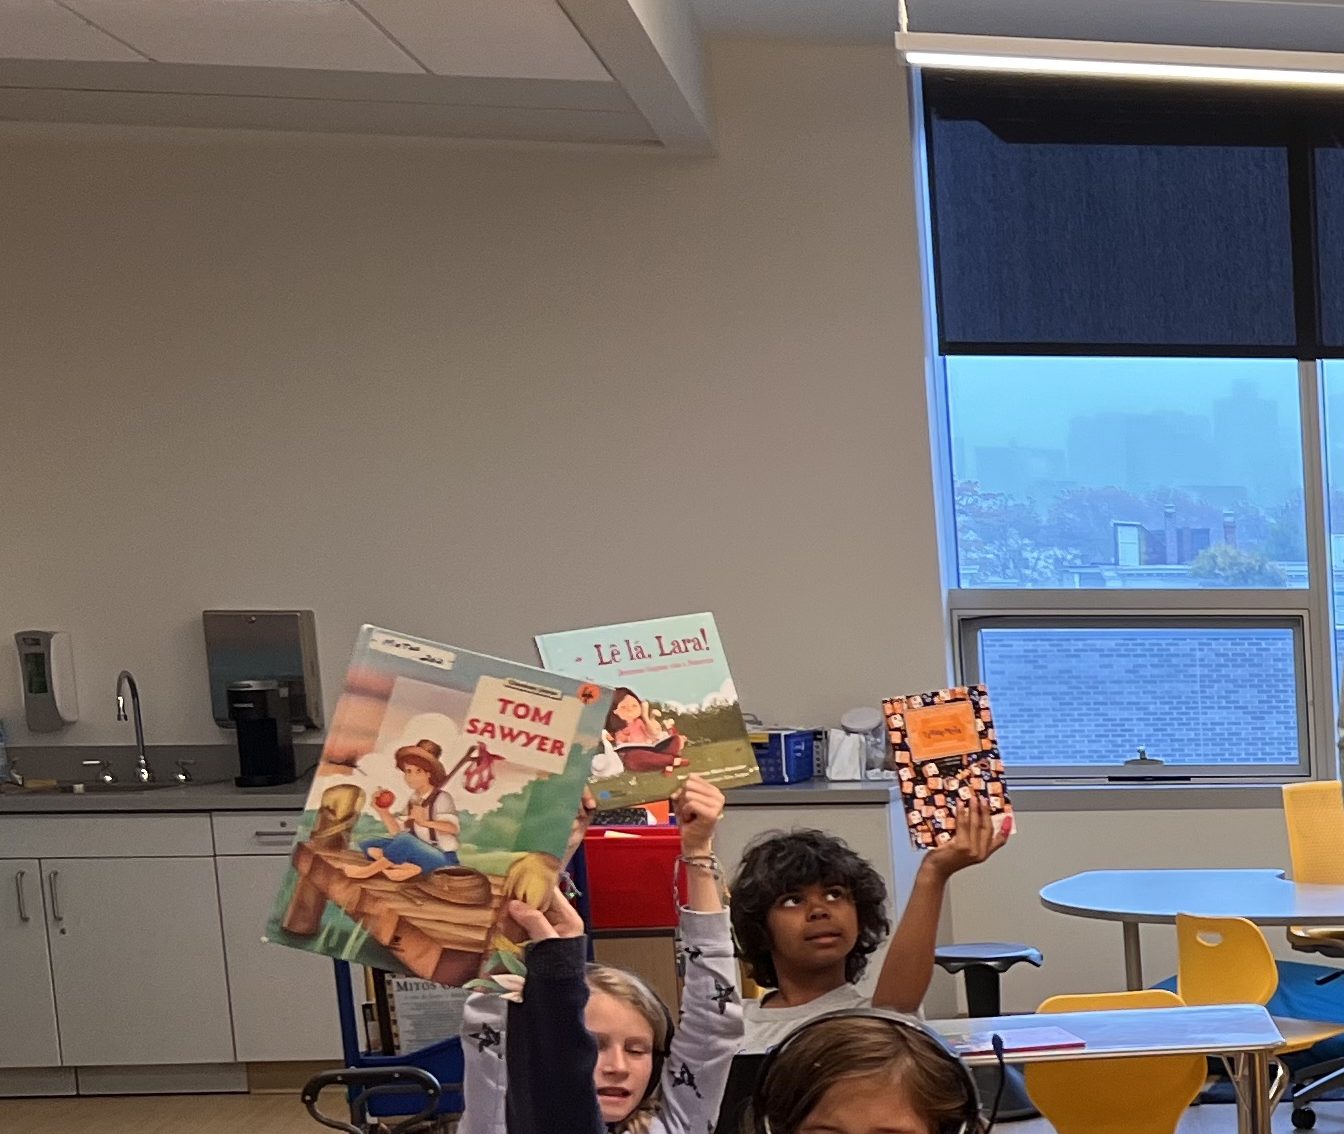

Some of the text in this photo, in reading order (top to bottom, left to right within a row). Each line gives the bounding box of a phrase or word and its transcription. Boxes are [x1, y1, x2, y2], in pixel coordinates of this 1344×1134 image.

[594, 643, 621, 666] Lê
[655, 627, 711, 657] Lara!
[498, 698, 554, 726] TOM
[466, 718, 566, 756] SAWYER
[396, 980, 437, 992] MITOS
